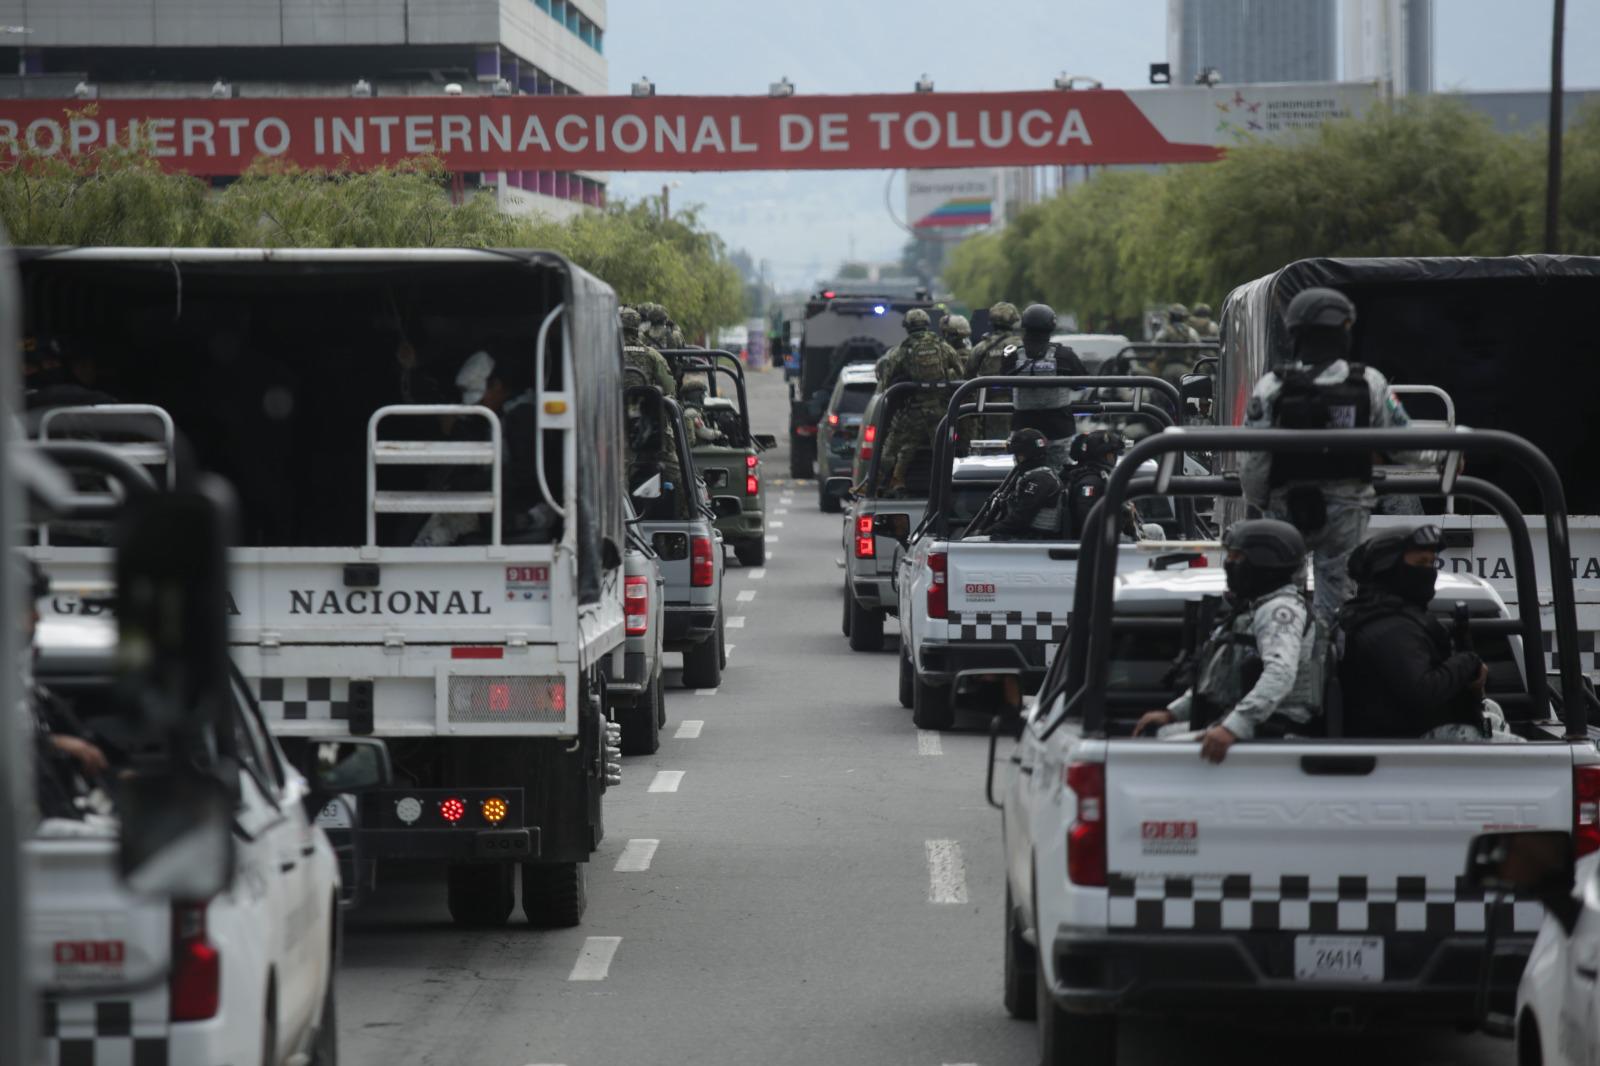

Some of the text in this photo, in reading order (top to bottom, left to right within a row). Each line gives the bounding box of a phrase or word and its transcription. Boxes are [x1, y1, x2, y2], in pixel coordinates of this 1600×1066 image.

[314, 115, 758, 154] INTERNACIONAL
[779, 113, 849, 151] DE
[869, 109, 1094, 150] TOLUCA
[506, 567, 548, 581] 911
[965, 584, 995, 593] 088
[289, 590, 491, 615] NACIONAL
[1139, 799, 1540, 825] CHEVROLET
[1316, 949, 1362, 969] 26414
